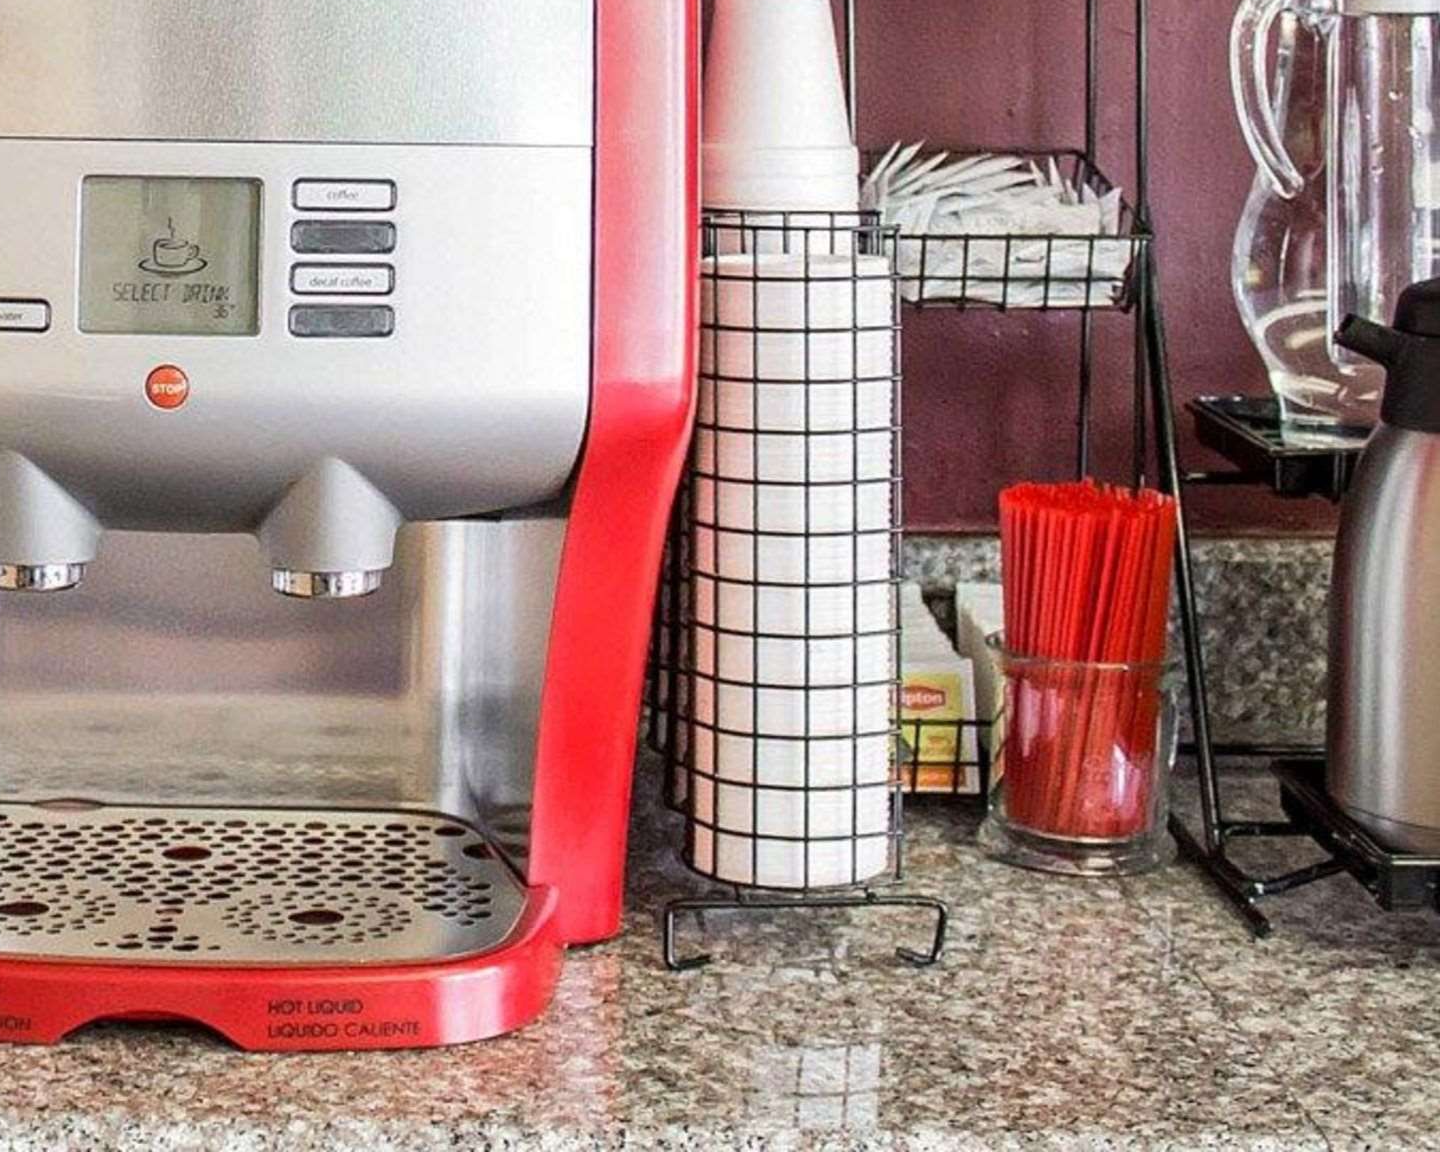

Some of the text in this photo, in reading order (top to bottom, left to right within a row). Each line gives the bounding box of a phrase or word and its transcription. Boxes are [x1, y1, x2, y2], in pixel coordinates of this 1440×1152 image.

[326, 189, 360, 201] coffee
[309, 276, 372, 287] decaf coffee
[112, 282, 171, 302] SELECT
[152, 382, 186, 396] STOP
[898, 690, 943, 706] ipton
[268, 999, 364, 1015] HOT LIQUID
[268, 1021, 420, 1039] LIQUIDO CALIENTE
